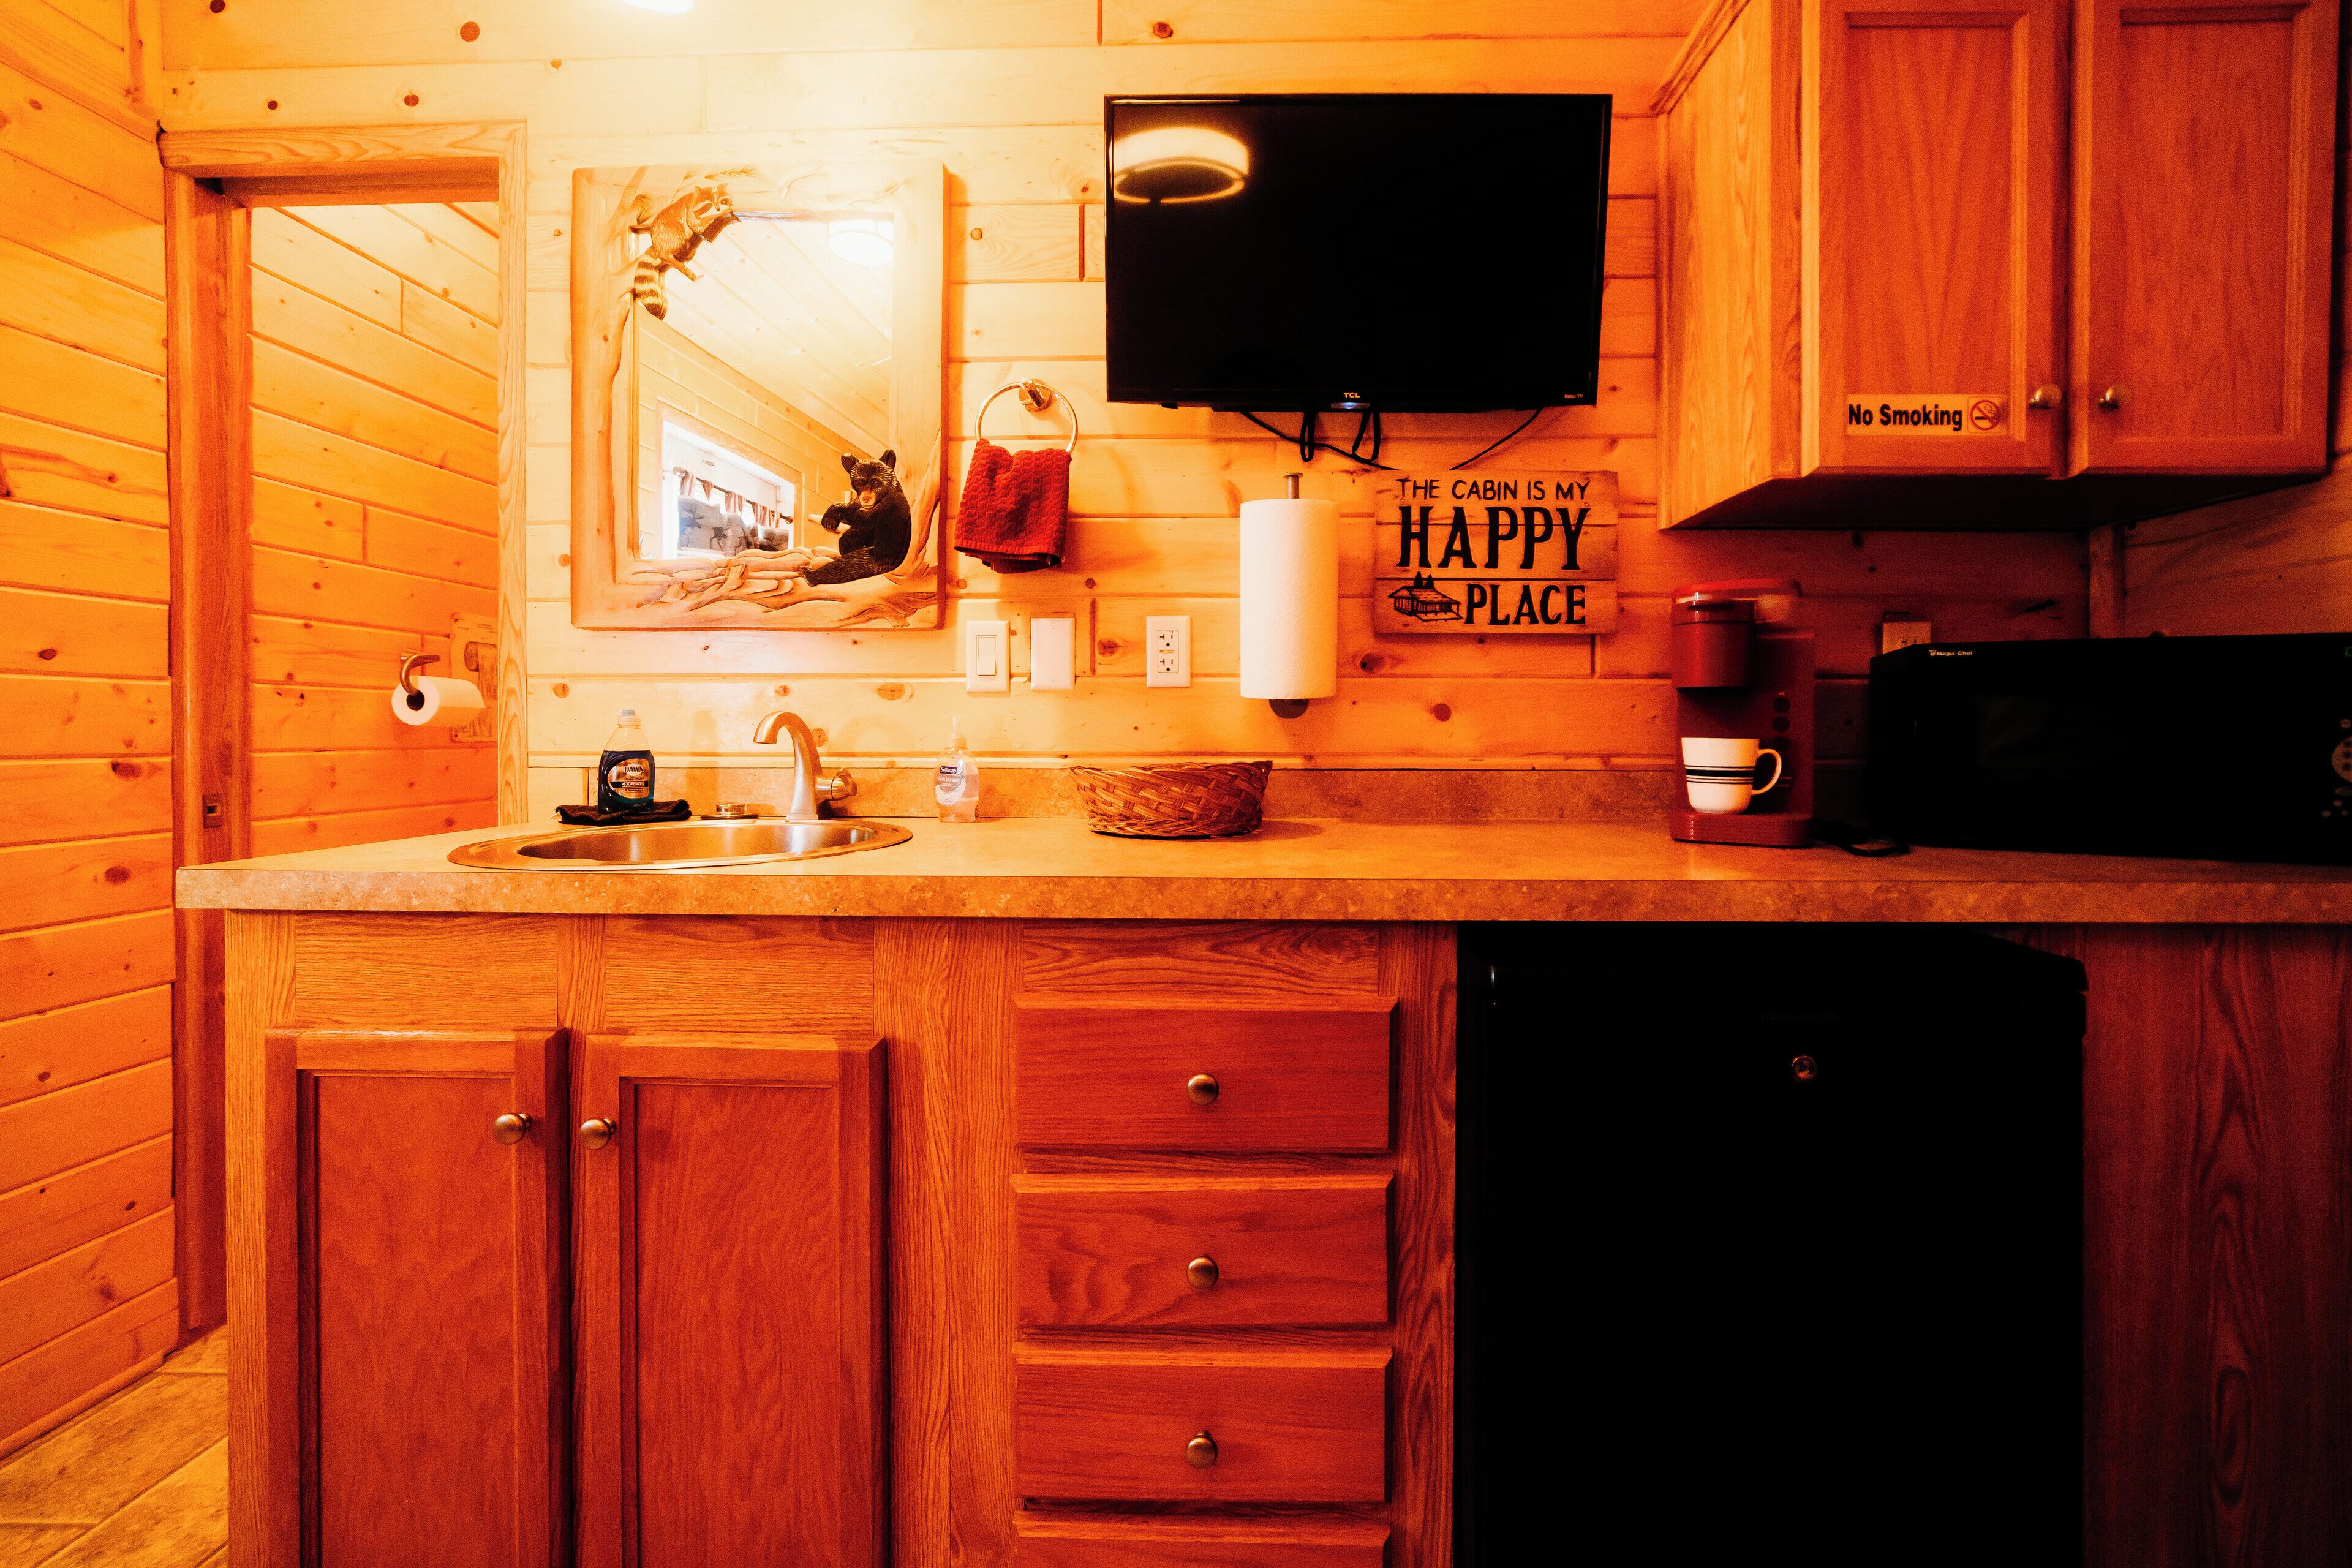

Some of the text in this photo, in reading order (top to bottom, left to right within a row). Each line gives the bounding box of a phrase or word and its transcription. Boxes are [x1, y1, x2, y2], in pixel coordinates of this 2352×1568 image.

[1849, 404, 1962, 431] No Smoking
[1395, 479, 1591, 501] THE CABIN IS MY
[1396, 505, 1591, 570] HAPPY
[1464, 583, 1586, 625] PLACE
